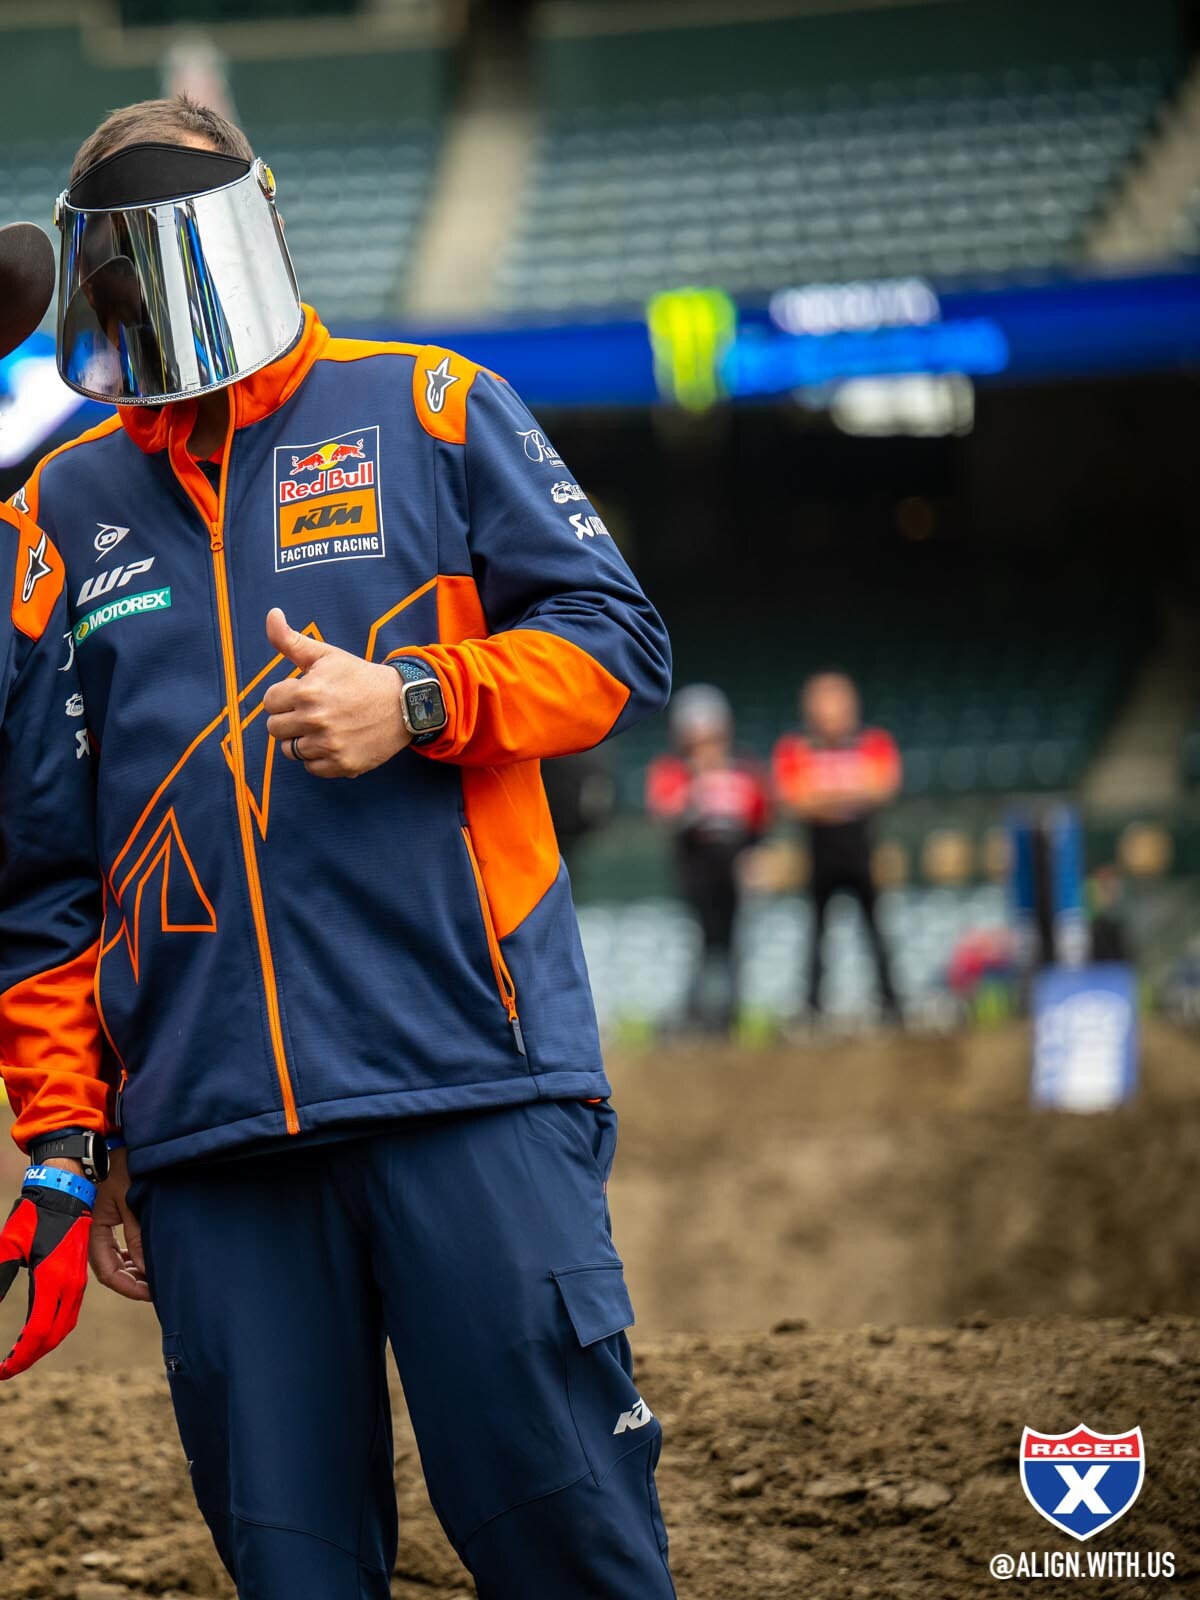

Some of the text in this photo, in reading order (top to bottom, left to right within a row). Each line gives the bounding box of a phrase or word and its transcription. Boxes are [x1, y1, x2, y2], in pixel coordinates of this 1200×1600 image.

[280, 461, 374, 503] Red Bull
[292, 503, 363, 534] KTM
[281, 537, 379, 563] FACTORY RACING
[77, 557, 155, 607] WP
[90, 591, 167, 631] MOTOREX
